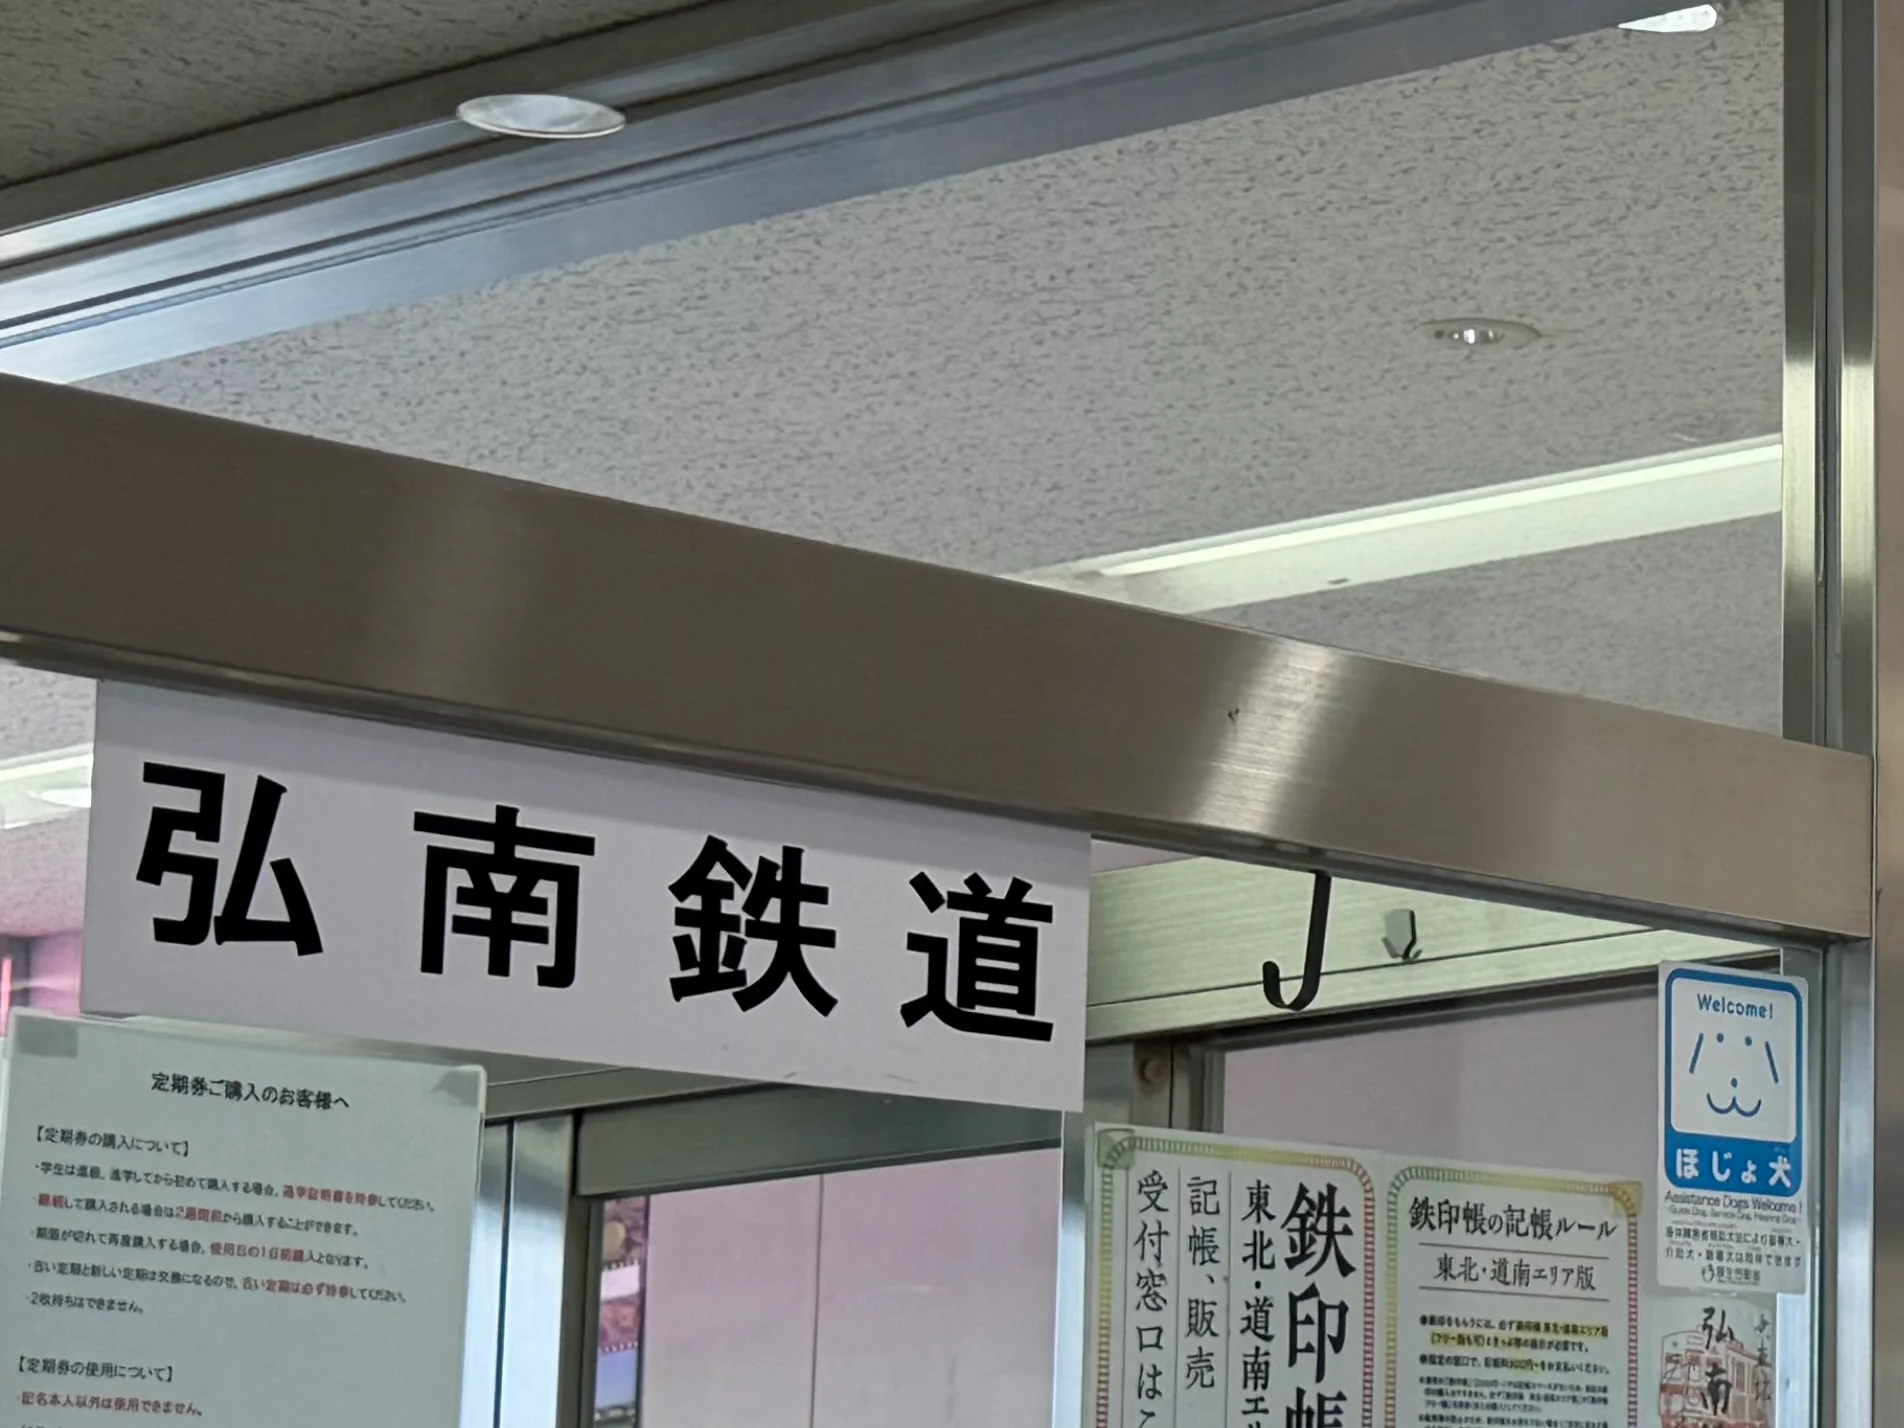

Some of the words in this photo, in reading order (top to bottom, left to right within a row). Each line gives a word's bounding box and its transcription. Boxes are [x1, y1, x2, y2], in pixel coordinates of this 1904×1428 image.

[136, 762, 1054, 1041] 弘南鉄道
[1697, 991, 1775, 1021] Welcome!
[151, 1072, 350, 1110] 定期券ご購入のお客様へ
[1674, 1146, 1794, 1190] ほじょ犬
[1408, 1195, 1618, 1241] 鉄印帳の記帳ルール
[1184, 1176, 1221, 1390] 記帳、販売
[1433, 1252, 1597, 1292] 東北・道南エリア版
